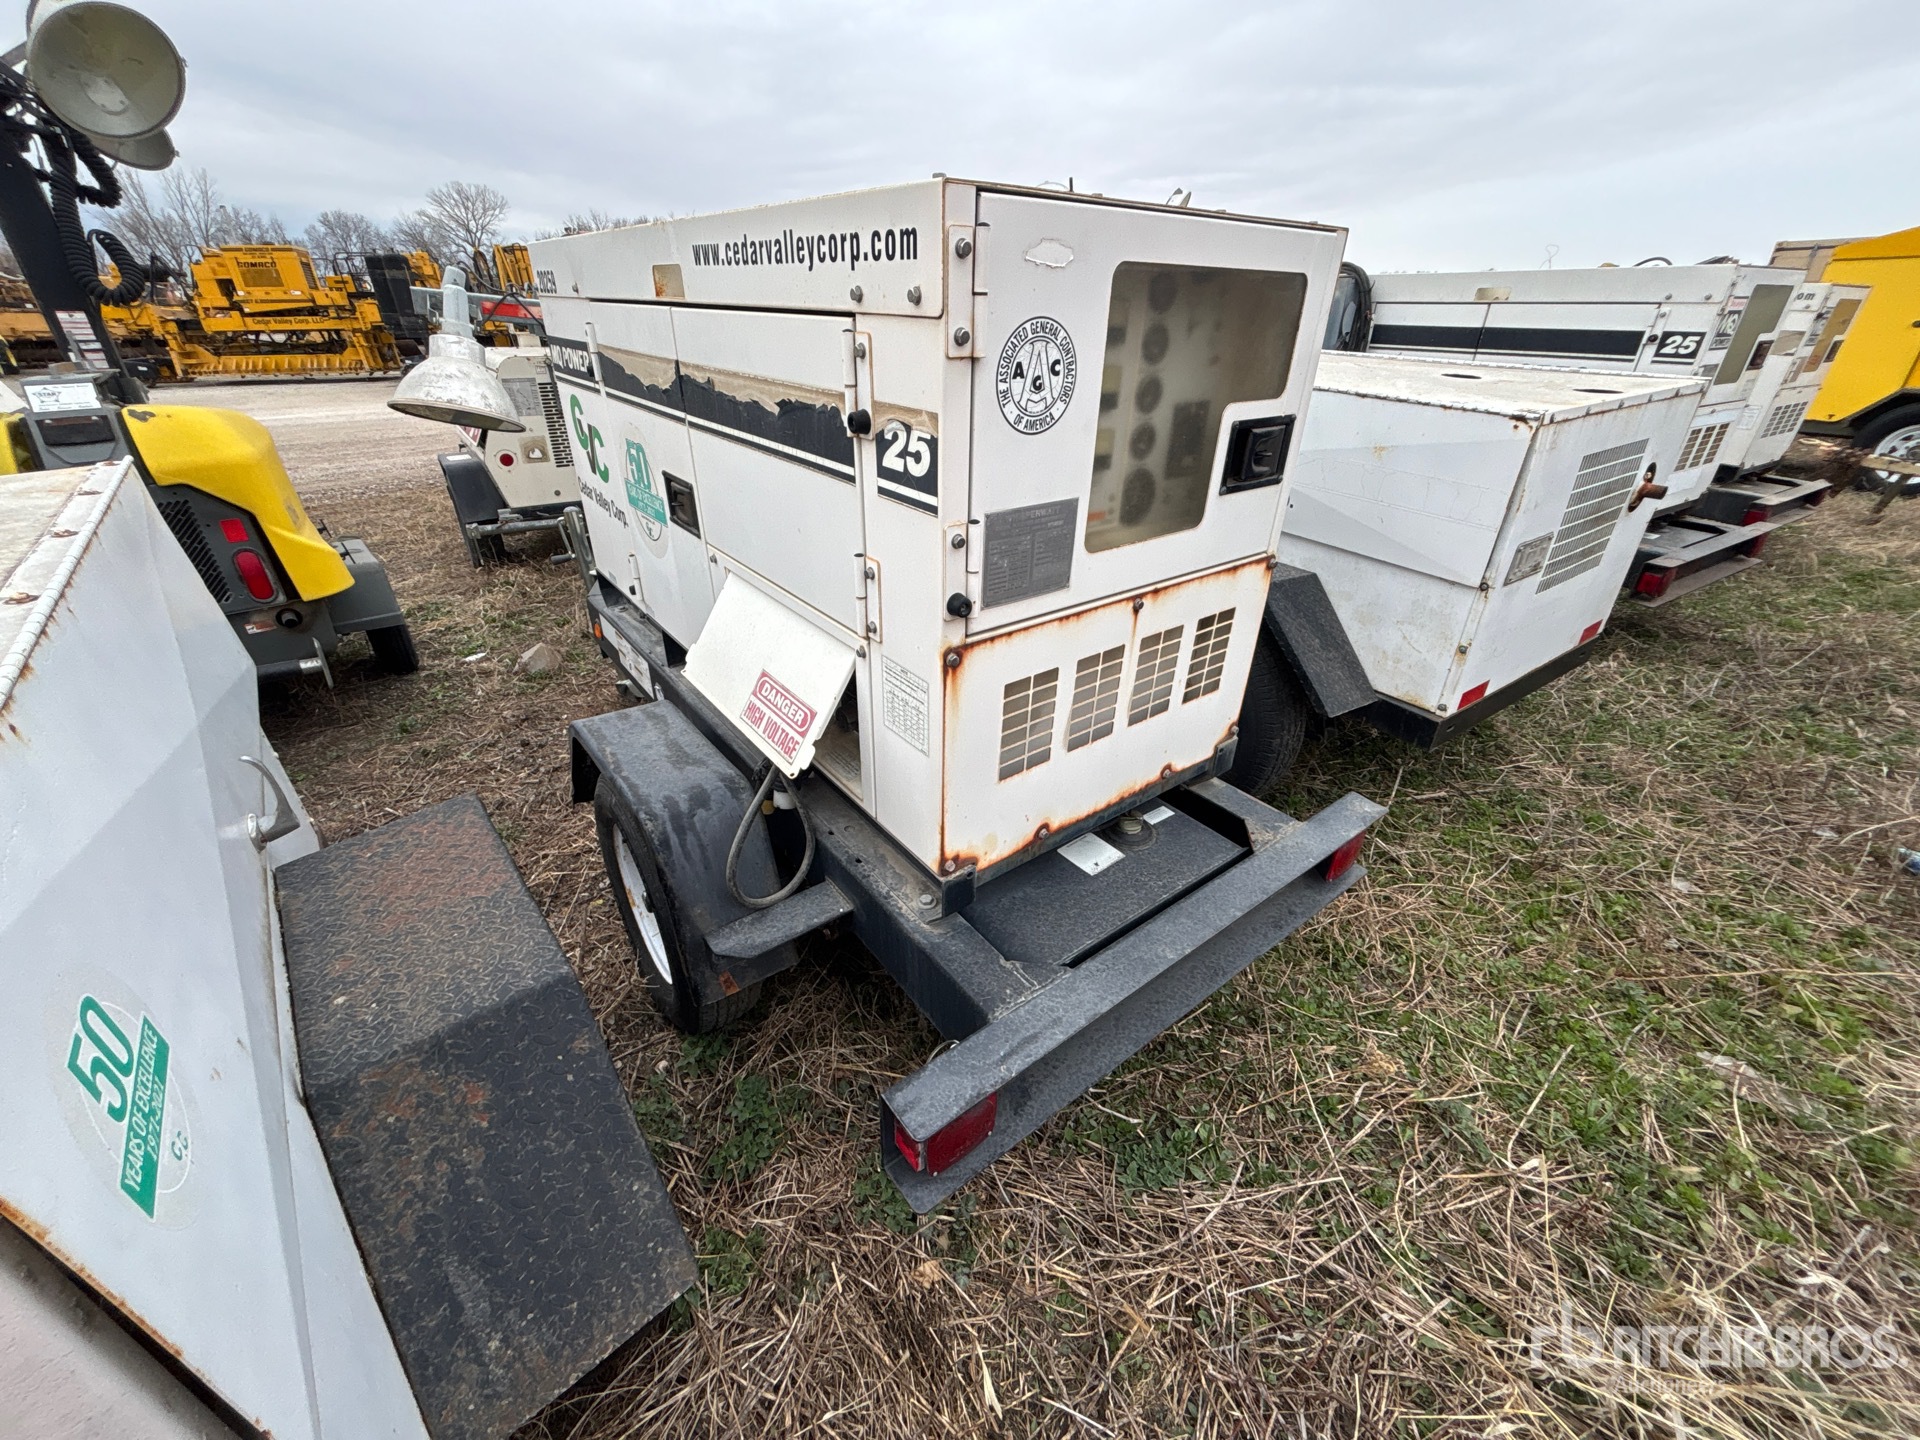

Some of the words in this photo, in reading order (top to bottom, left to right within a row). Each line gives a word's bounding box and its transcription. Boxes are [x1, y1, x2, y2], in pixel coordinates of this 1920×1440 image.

[692, 226, 918, 272] www.cedarvalleycorp.com
[274, 317, 293, 326] Valley
[1030, 320, 1061, 341] GENERAL
[1658, 335, 1702, 355] 25
[562, 346, 588, 371] POWER
[999, 327, 1029, 384] ASSOCIATED
[1059, 335, 1075, 405] CONTRACTORS
[999, 386, 1011, 409] THE
[1013, 413, 1022, 427] OF
[1023, 411, 1056, 432] AMERICA
[625, 438, 652, 492] 50
[882, 420, 931, 477] 25
[578, 476, 594, 501] Cedar
[592, 486, 612, 518] Valley
[611, 499, 629, 529] Corp.
[743, 700, 767, 730] HIGH
[762, 715, 800, 760] VOLTAGE
[760, 682, 805, 726] DANGER
[67, 996, 135, 1123] 50
[134, 1025, 159, 1112] EXCELLENCE
[132, 1111, 147, 1136] OF
[146, 1076, 165, 1162] 1971-2021
[124, 1136, 147, 1192] YEARS
